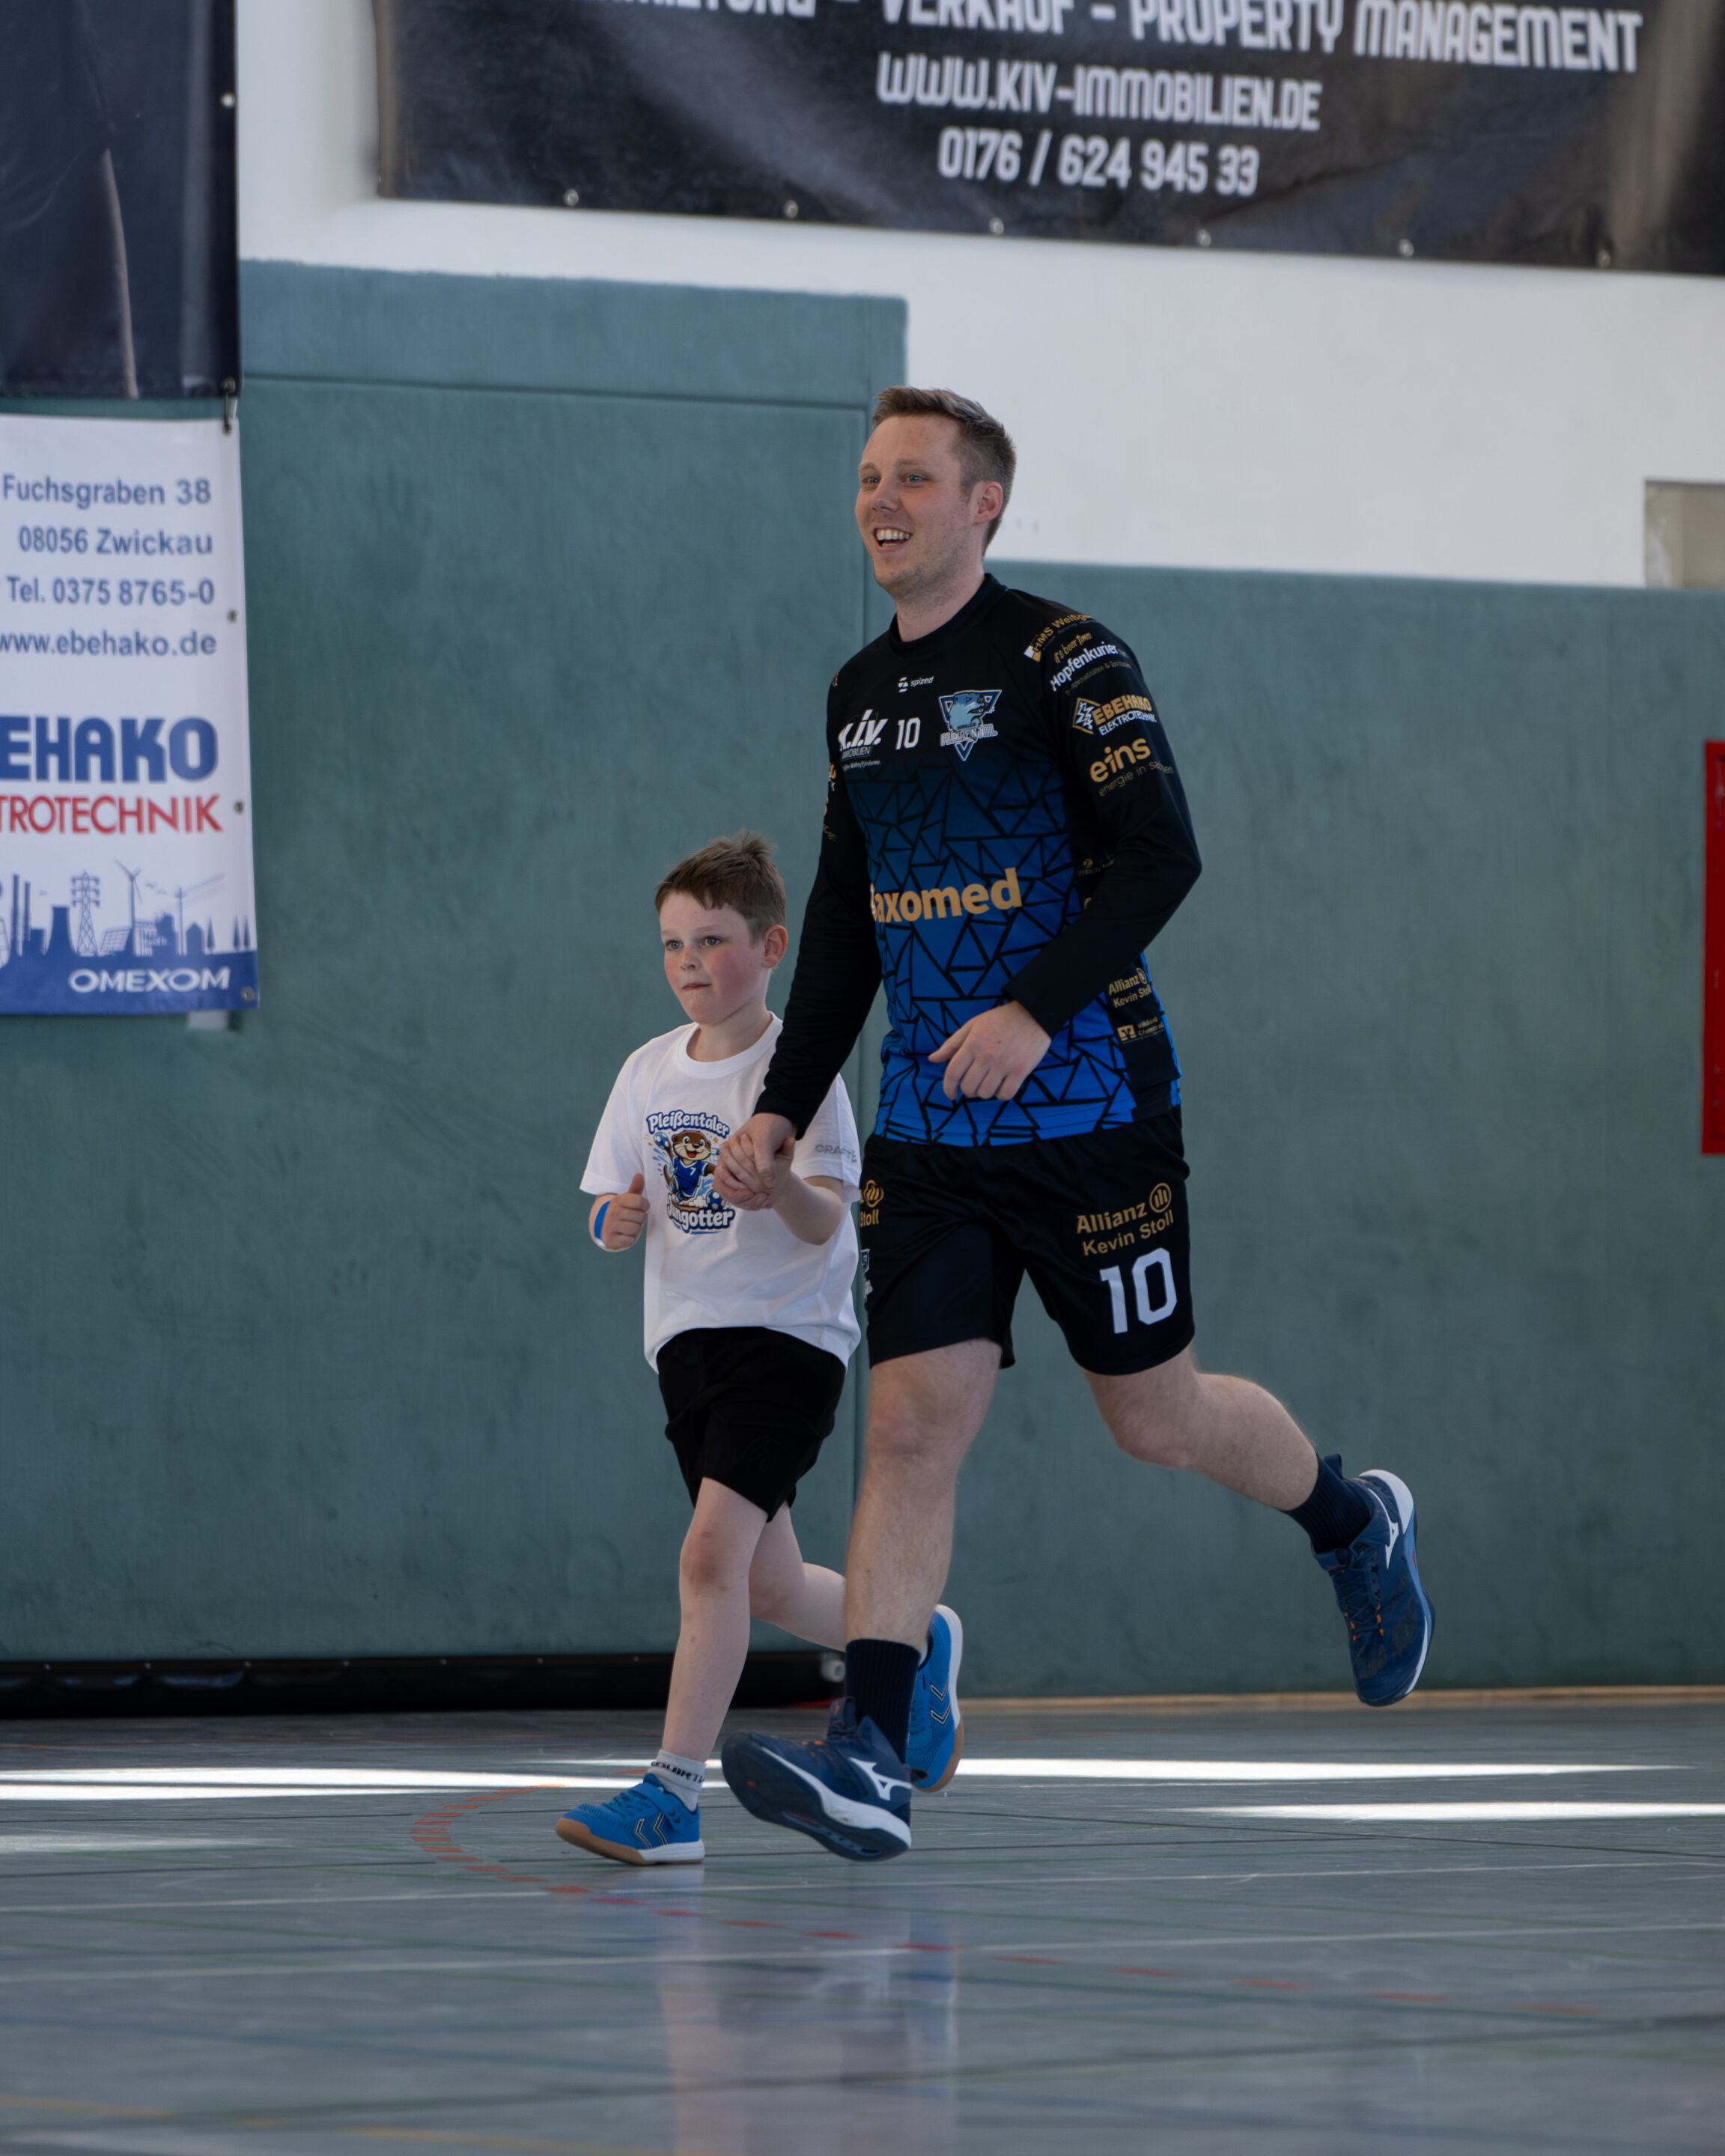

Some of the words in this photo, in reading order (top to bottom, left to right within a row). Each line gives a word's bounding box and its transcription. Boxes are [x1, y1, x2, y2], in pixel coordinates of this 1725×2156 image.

[1130, 0, 1344, 54] PROPERTY
[1352, 0, 1643, 73] MANAGEMENT
[938, 126, 1023, 182] 0176
[1029, 129, 1053, 187] /
[1057, 133, 1131, 189] 624
[1140, 138, 1209, 195] 945
[1215, 144, 1260, 196] 33
[3, 474, 165, 510] Fuchsgraben
[176, 478, 211, 504] 38
[19, 526, 88, 553] 08056
[97, 528, 213, 555] Zwickau
[7, 576, 45, 602] Tel.
[52, 577, 110, 605] 0375
[119, 579, 215, 606] 8765-0
[0, 630, 216, 656] www.ebehako.de
[910, 676, 934, 686] spized
[1050, 642, 1119, 692] Hopfenkurier
[1092, 695, 1152, 725] EBEHAKO
[1098, 710, 1157, 736] ELEKTROTECHNIK
[895, 716, 921, 750] 10
[0, 716, 219, 783] EHAKO
[1090, 738, 1151, 782] eins
[1099, 771, 1134, 797] energie
[1137, 765, 1146, 776] in
[69, 966, 230, 993] OMEXOM
[1109, 974, 1140, 996] Allianz
[1113, 993, 1138, 1008] Kevin
[648, 1111, 729, 1136] Pleißentaler
[1077, 1202, 1148, 1234] Allianz
[1083, 1232, 1135, 1255] Kevin
[1140, 1209, 1174, 1240] Stoll
[1099, 1247, 1178, 1334] 10
